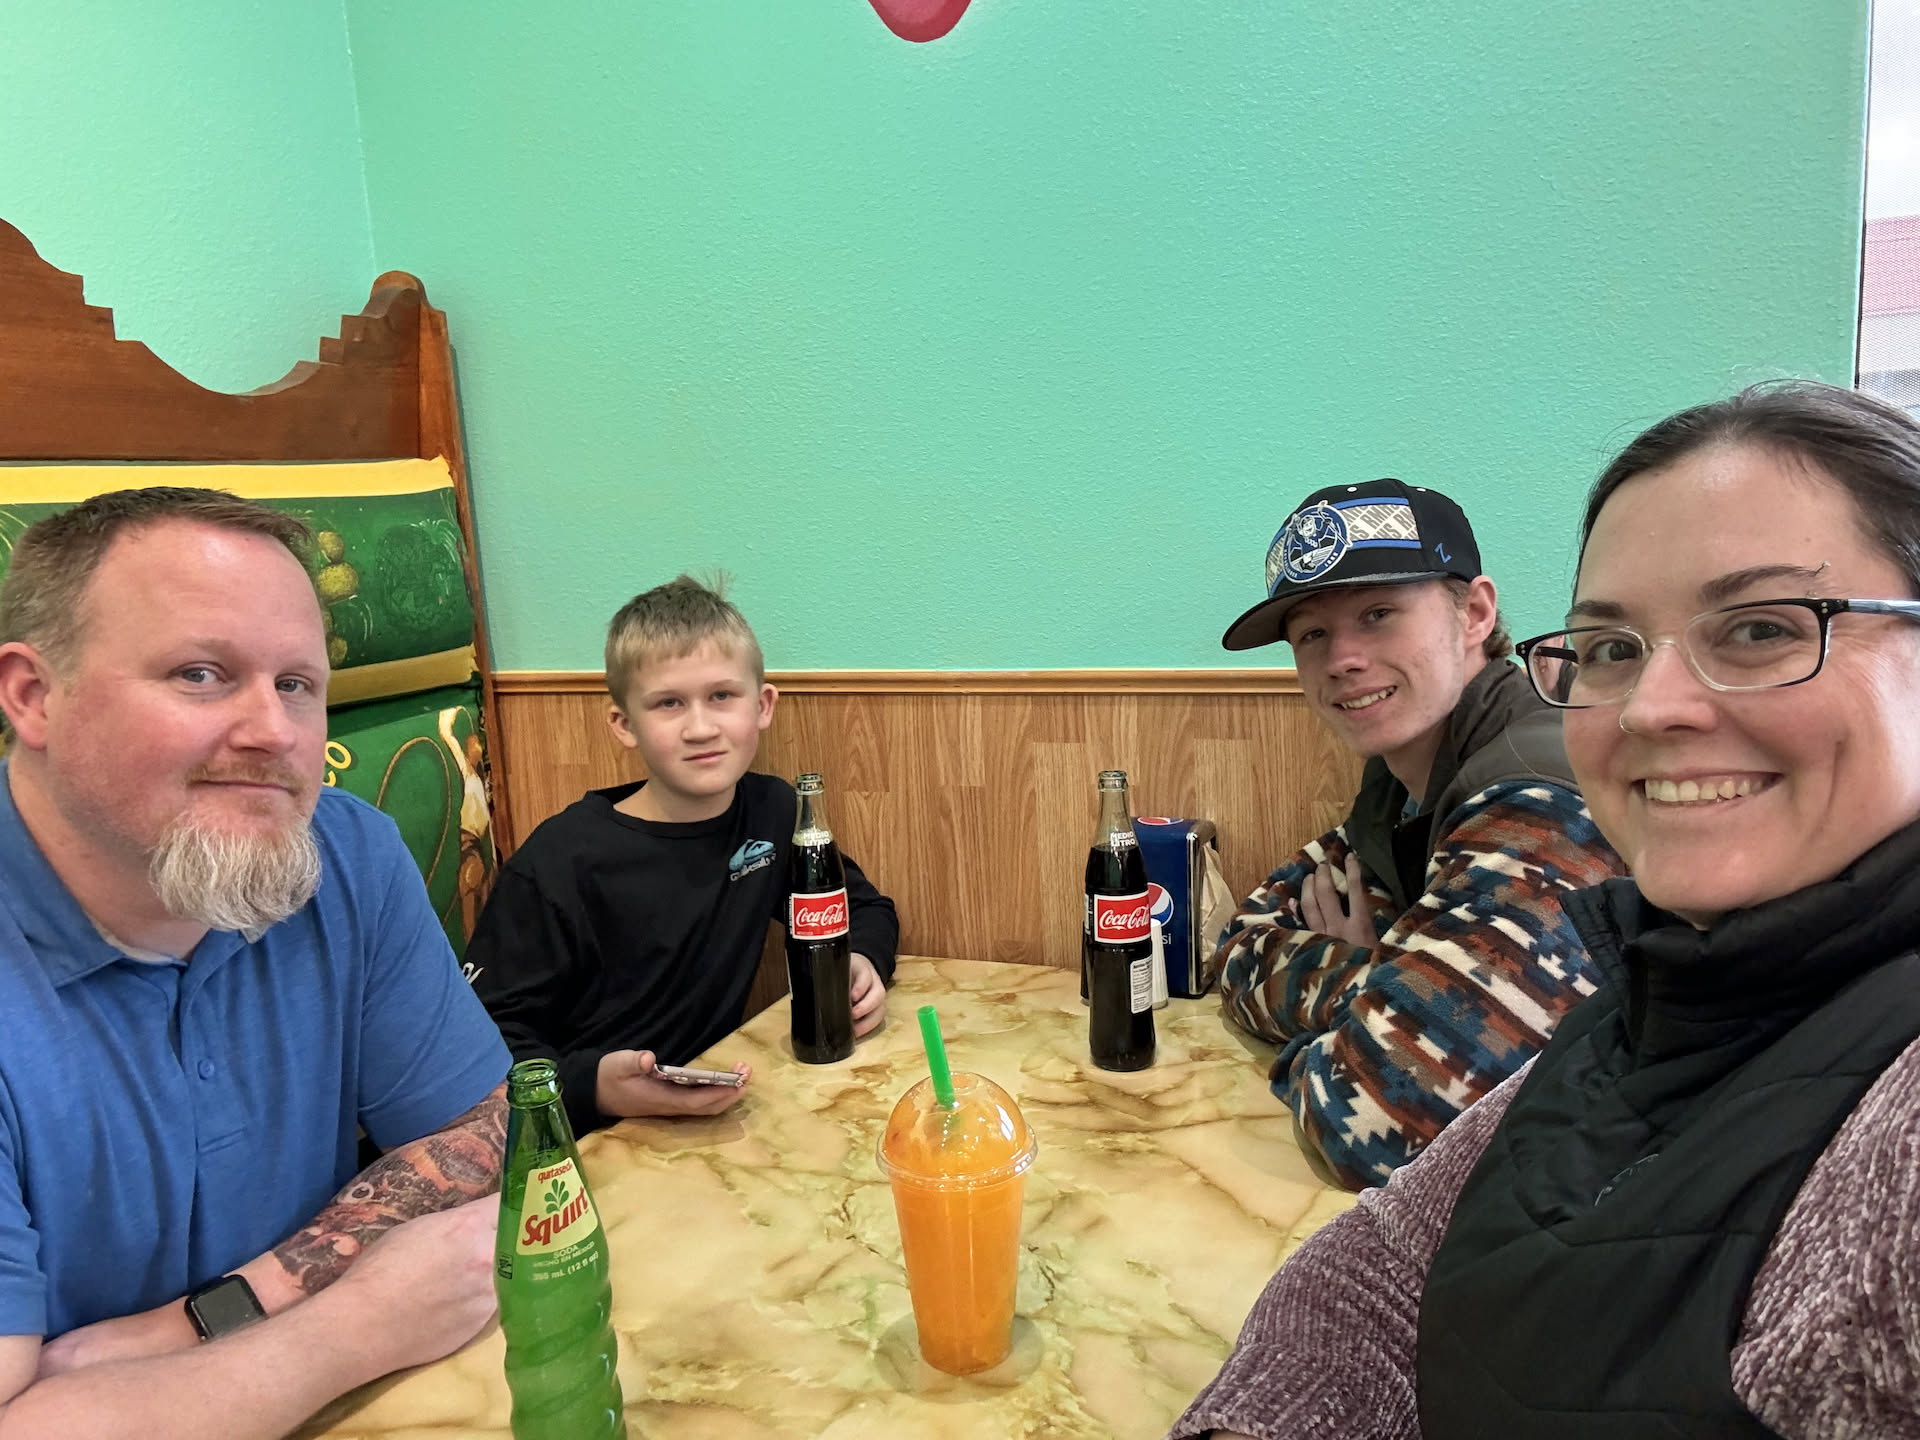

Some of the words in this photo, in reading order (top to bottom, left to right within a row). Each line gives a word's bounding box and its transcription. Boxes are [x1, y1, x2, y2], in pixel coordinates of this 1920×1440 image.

[1110, 830, 1134, 840] MEDIO
[1110, 838, 1136, 847] LITRO
[795, 902, 845, 927] Coca-Cola
[1100, 904, 1149, 930] Coca-Cola
[522, 1186, 588, 1246] Squirt
[553, 1244, 579, 1259] SODA
